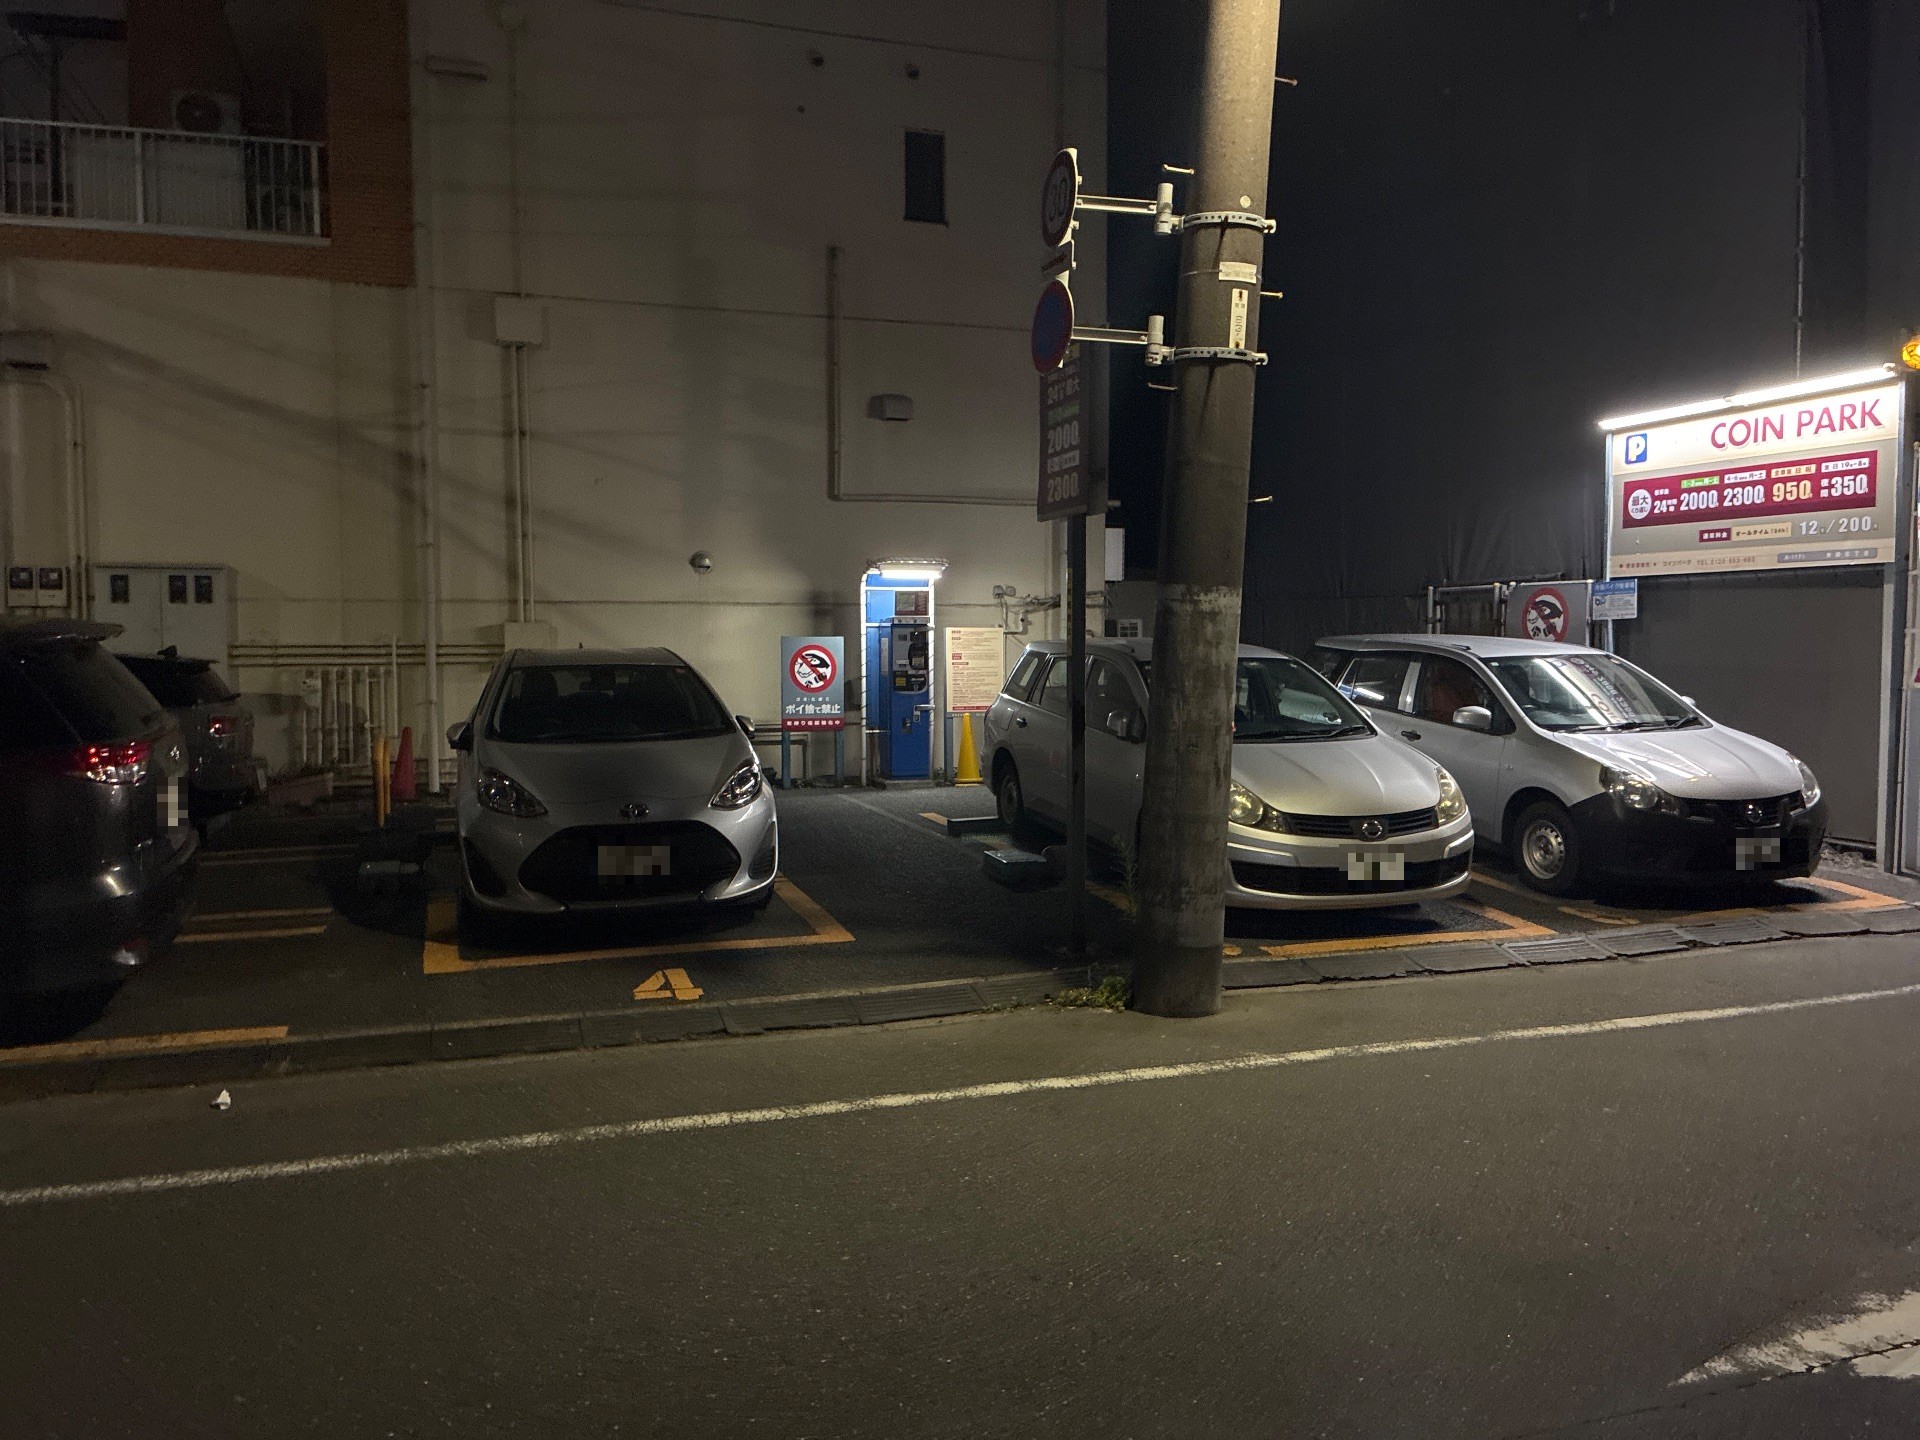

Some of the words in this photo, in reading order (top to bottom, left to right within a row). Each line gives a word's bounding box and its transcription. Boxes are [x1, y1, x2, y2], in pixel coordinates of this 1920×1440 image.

[1711, 414, 1783, 449] COIN
[1797, 399, 1882, 437] PARK
[1048, 420, 1080, 454] 2000
[1632, 494, 1649, 506] 最大
[1680, 490, 1718, 511] 2000
[1723, 485, 1765, 507] 2300
[1772, 480, 1812, 502] 950
[785, 703, 842, 715] ポイ捨て禁止
